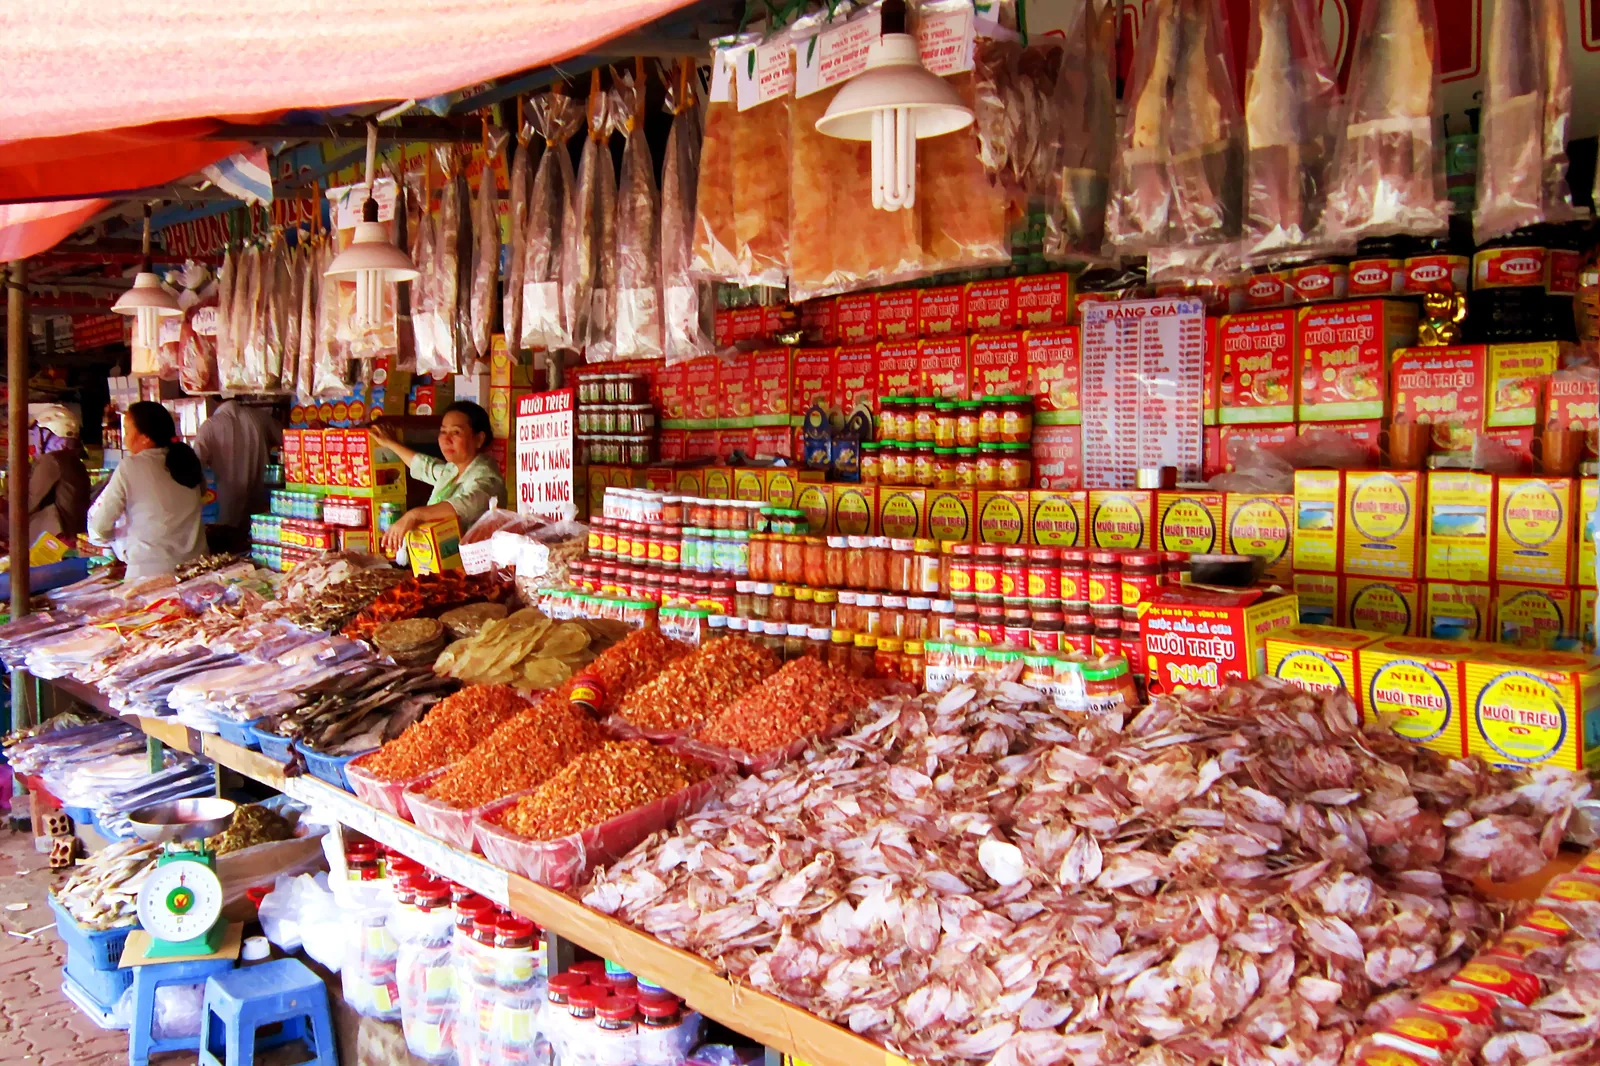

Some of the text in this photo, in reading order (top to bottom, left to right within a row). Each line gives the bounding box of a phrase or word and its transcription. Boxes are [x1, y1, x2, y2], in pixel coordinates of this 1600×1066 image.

[1107, 304, 1146, 319] BẢNG
[1151, 302, 1176, 316] GIÁ
[542, 451, 546, 470] 1
[538, 483, 542, 503] 1
[1186, 636, 1235, 663] TRIỆU
